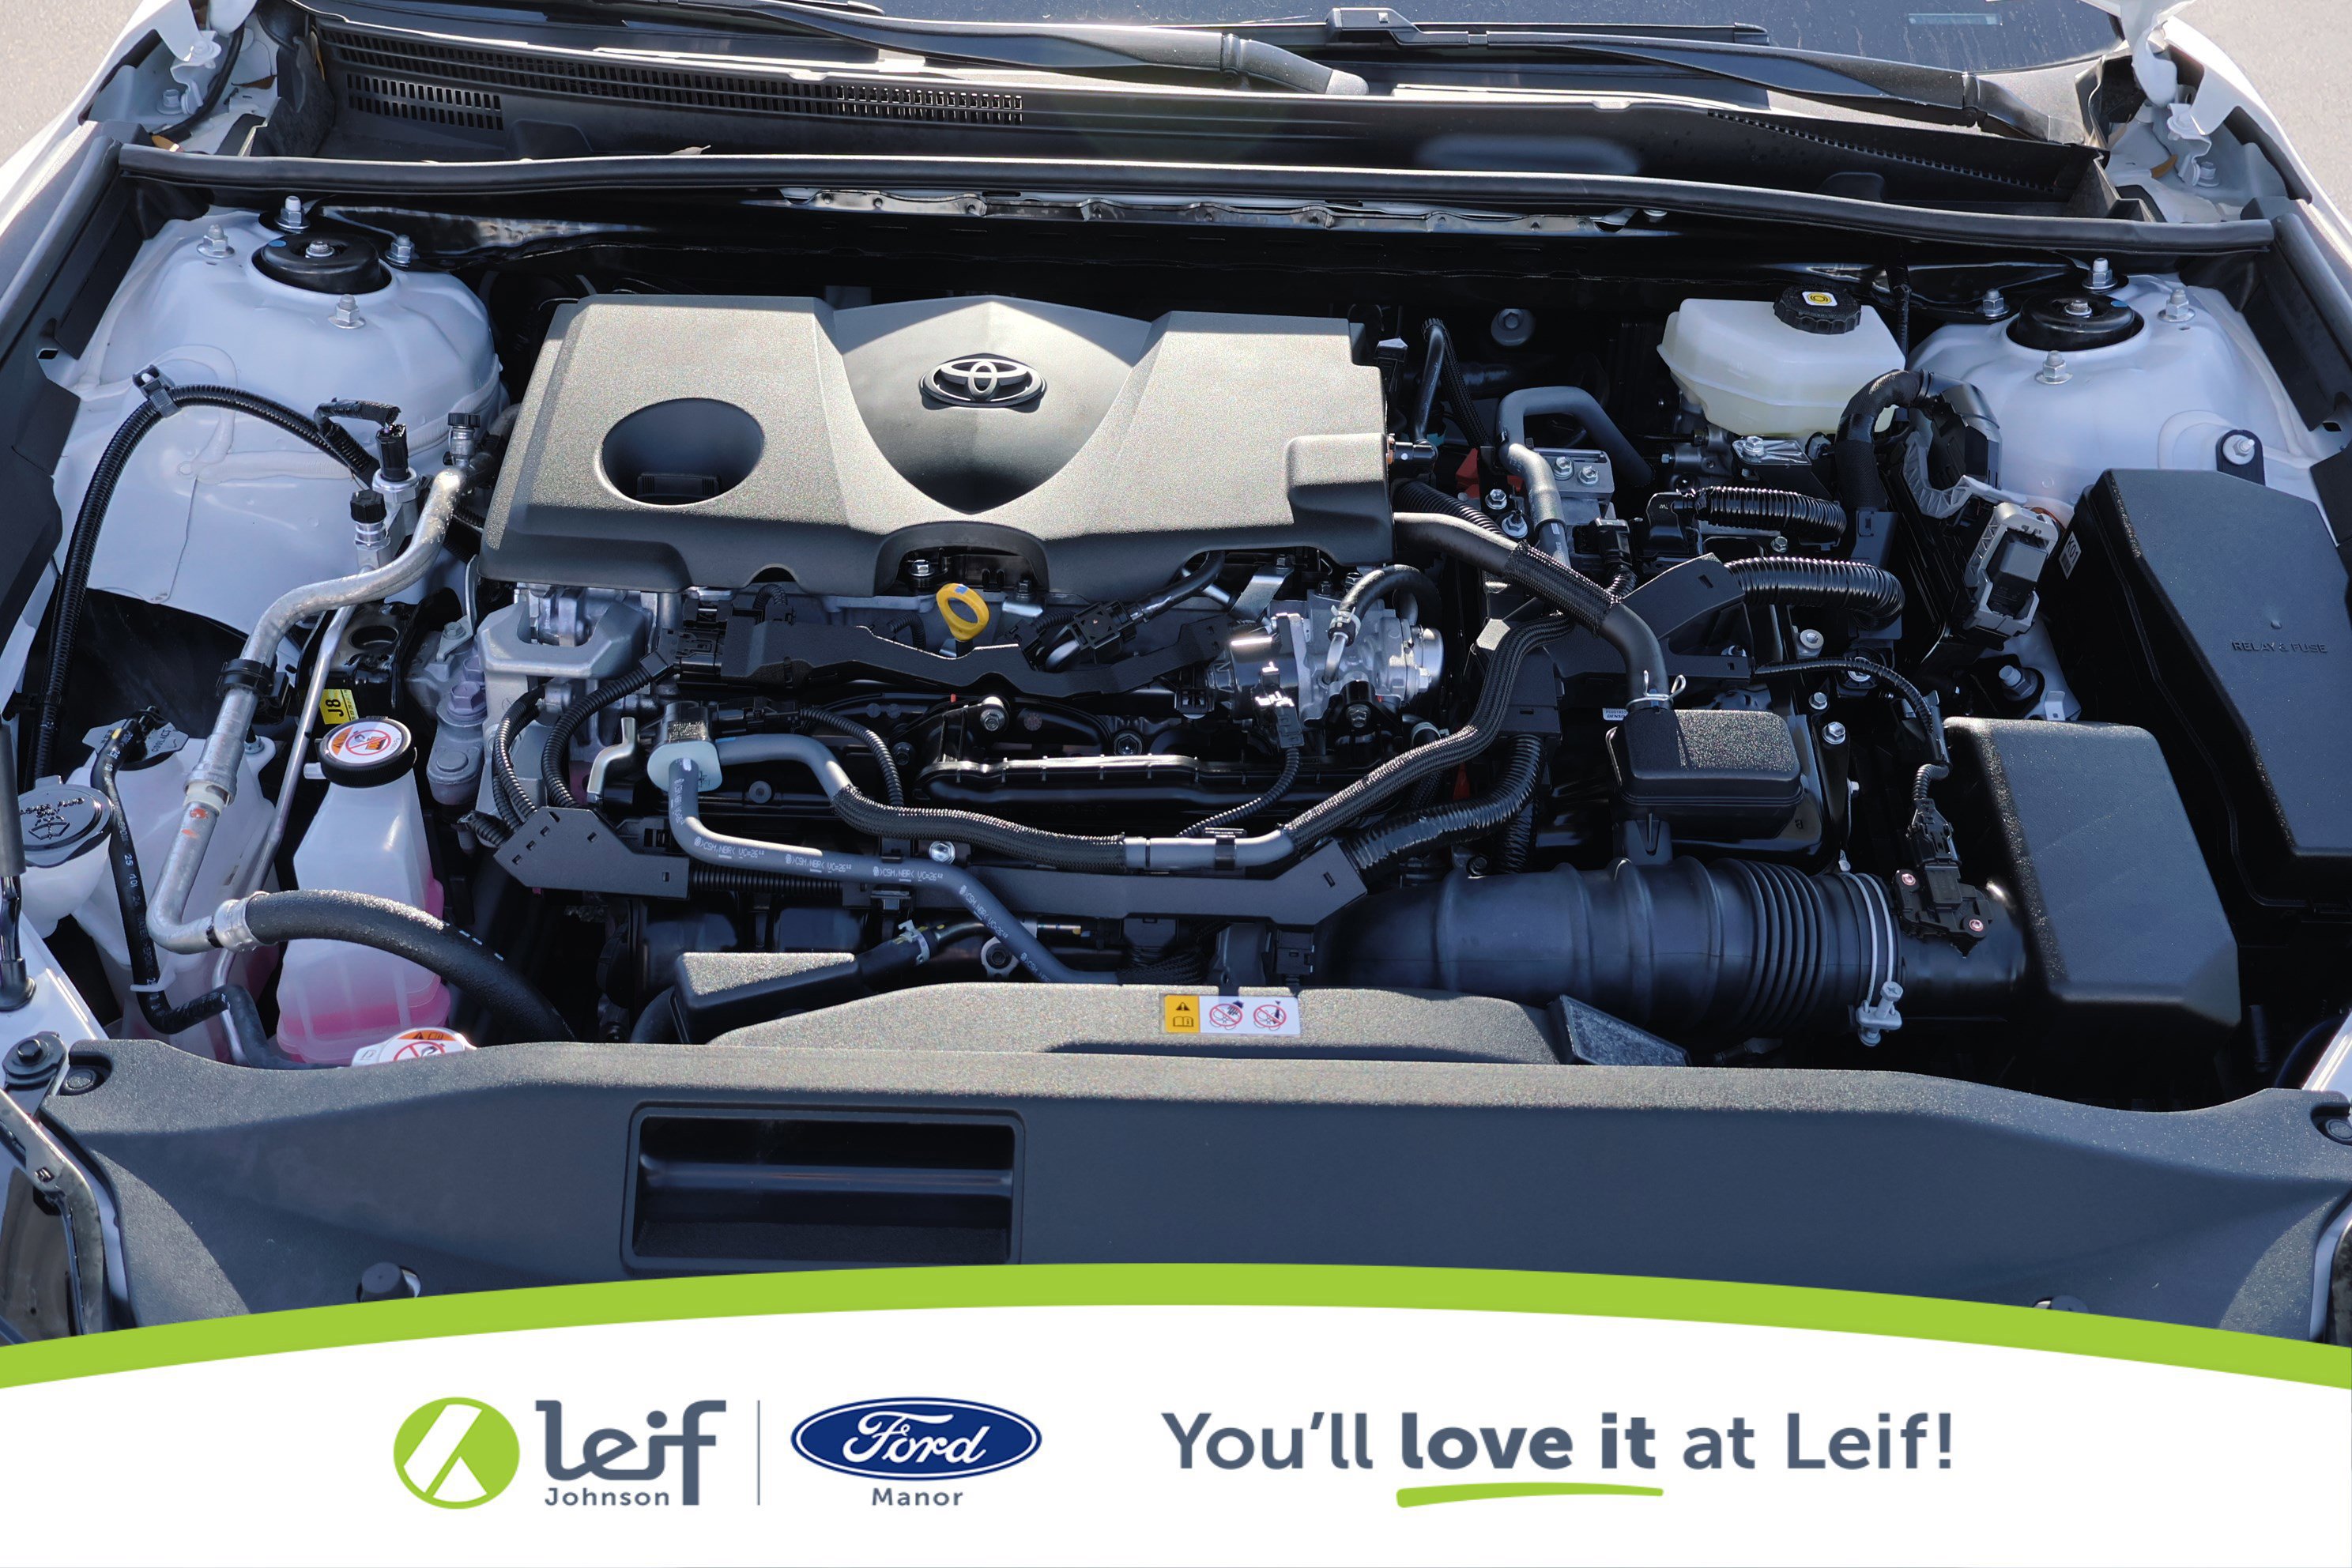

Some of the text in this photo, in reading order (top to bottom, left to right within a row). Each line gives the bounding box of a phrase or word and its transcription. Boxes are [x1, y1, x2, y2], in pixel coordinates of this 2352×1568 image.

[2231, 642, 2328, 654] RELAY & FUSE
[325, 699, 345, 718] J8
